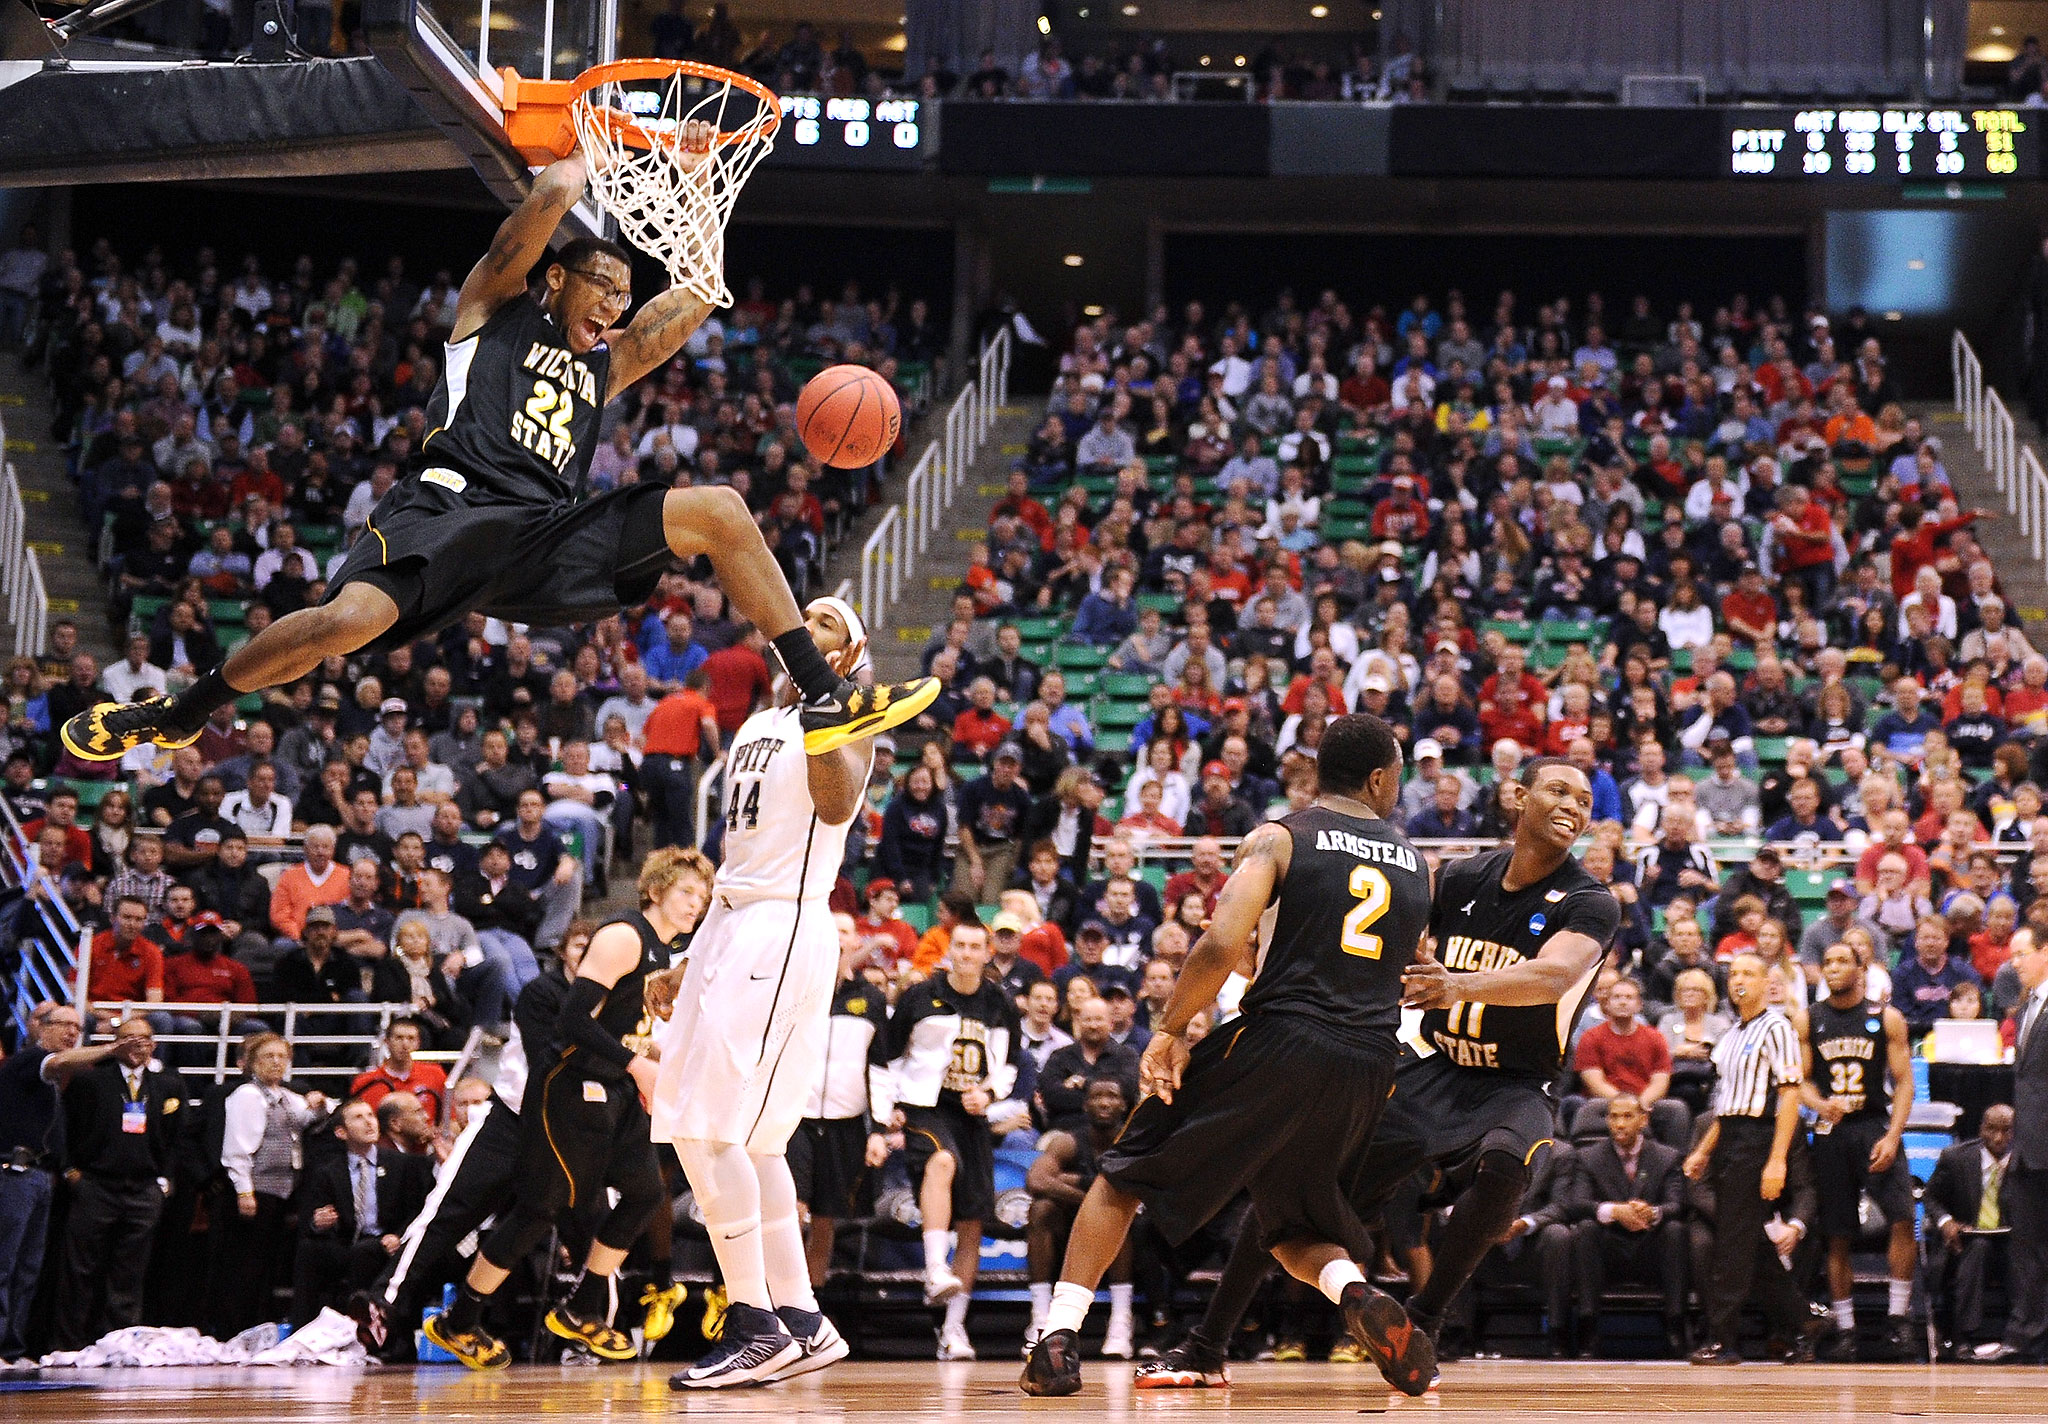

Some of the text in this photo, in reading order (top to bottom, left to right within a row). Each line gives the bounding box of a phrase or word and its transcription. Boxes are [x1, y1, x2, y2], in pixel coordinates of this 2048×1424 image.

[844, 120, 870, 147] 0
[893, 121, 919, 149] 0
[1732, 129, 1787, 152] PITT
[1802, 151, 1832, 174] 10
[1897, 152, 1912, 174] 1
[1935, 151, 1965, 174] 10
[525, 379, 574, 442] 22
[729, 737, 786, 778] PITT
[726, 781, 761, 832] 44
[1315, 830, 1418, 873] ARMSTEAD
[1340, 864, 1392, 961] 2
[1443, 935, 1528, 973] WICHIT
[1829, 1062, 1865, 1095] 32
